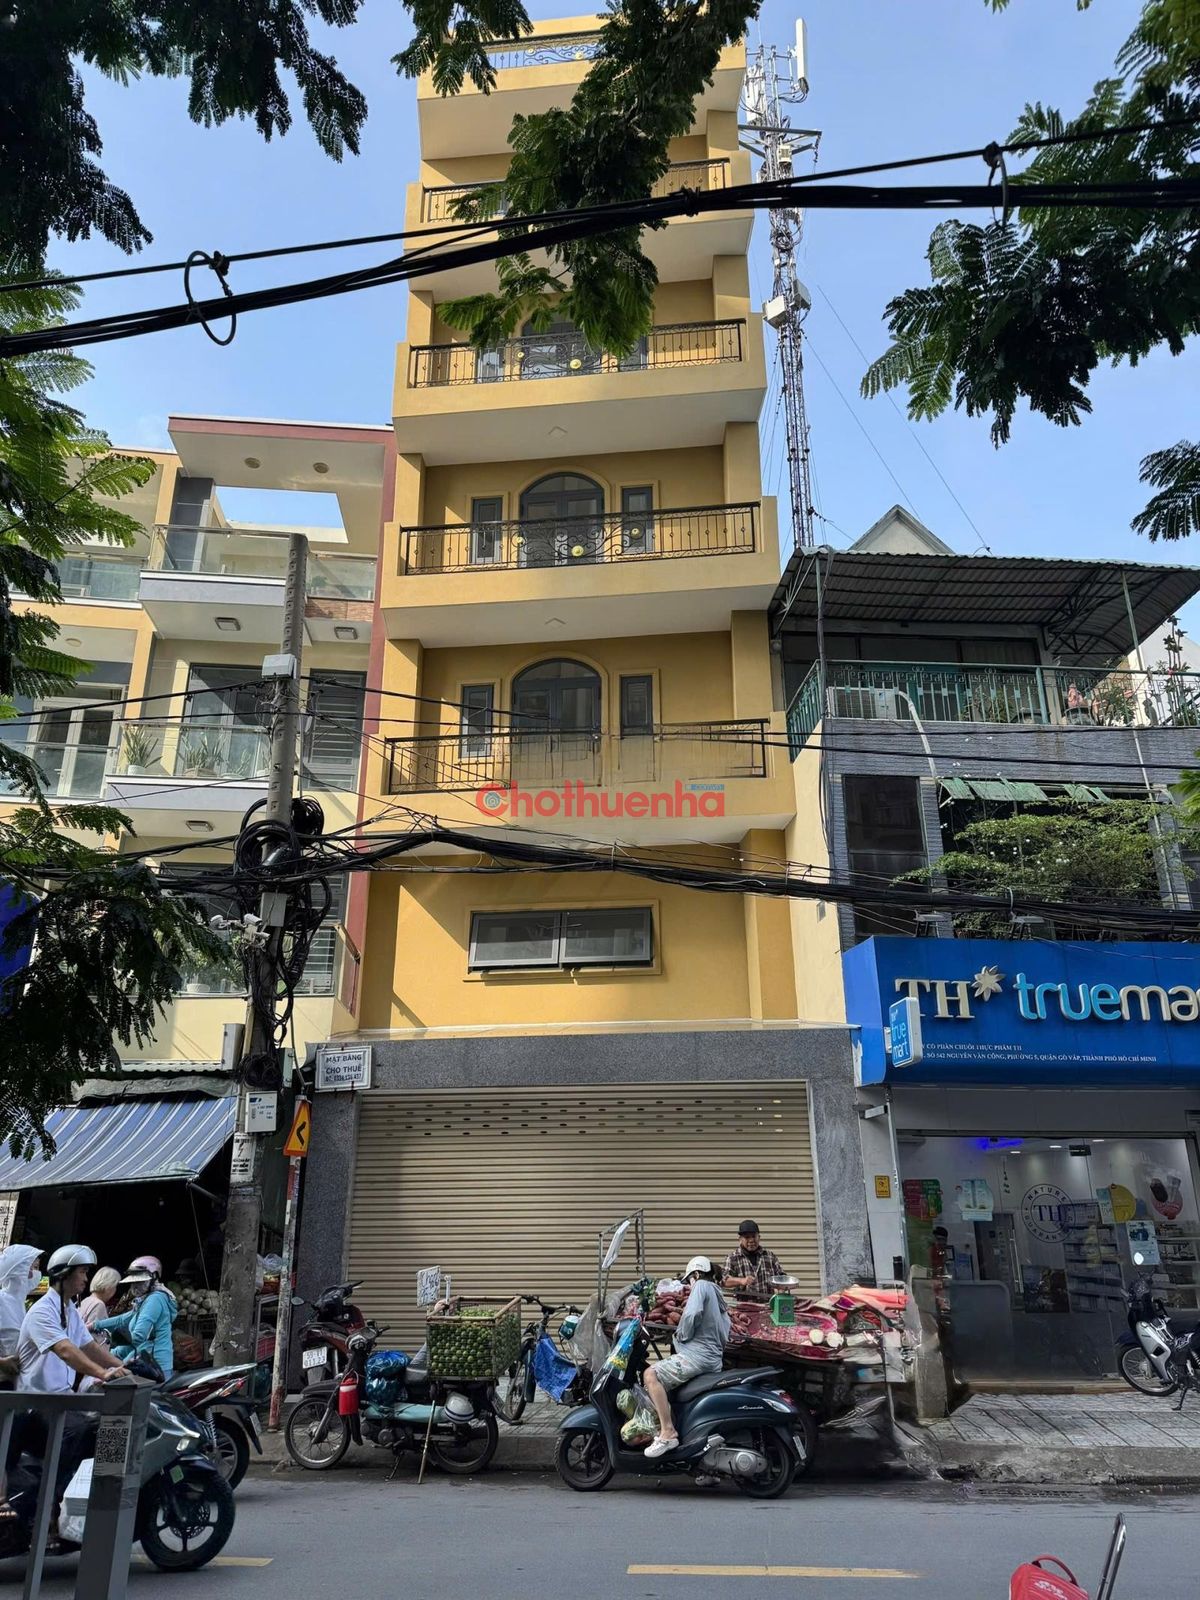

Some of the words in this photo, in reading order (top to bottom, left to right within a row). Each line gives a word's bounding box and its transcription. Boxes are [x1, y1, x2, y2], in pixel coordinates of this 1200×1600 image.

[895, 978, 975, 1018] TH
[1013, 972, 1200, 1021] truema
[891, 1022, 907, 1042] true
[893, 1038, 909, 1061] mart
[1082, 1053, 1104, 1061] THÀNH
[1127, 1054, 1140, 1062] CHÍ
[325, 1066, 341, 1074] CHO
[343, 1063, 362, 1073] THUÊ
